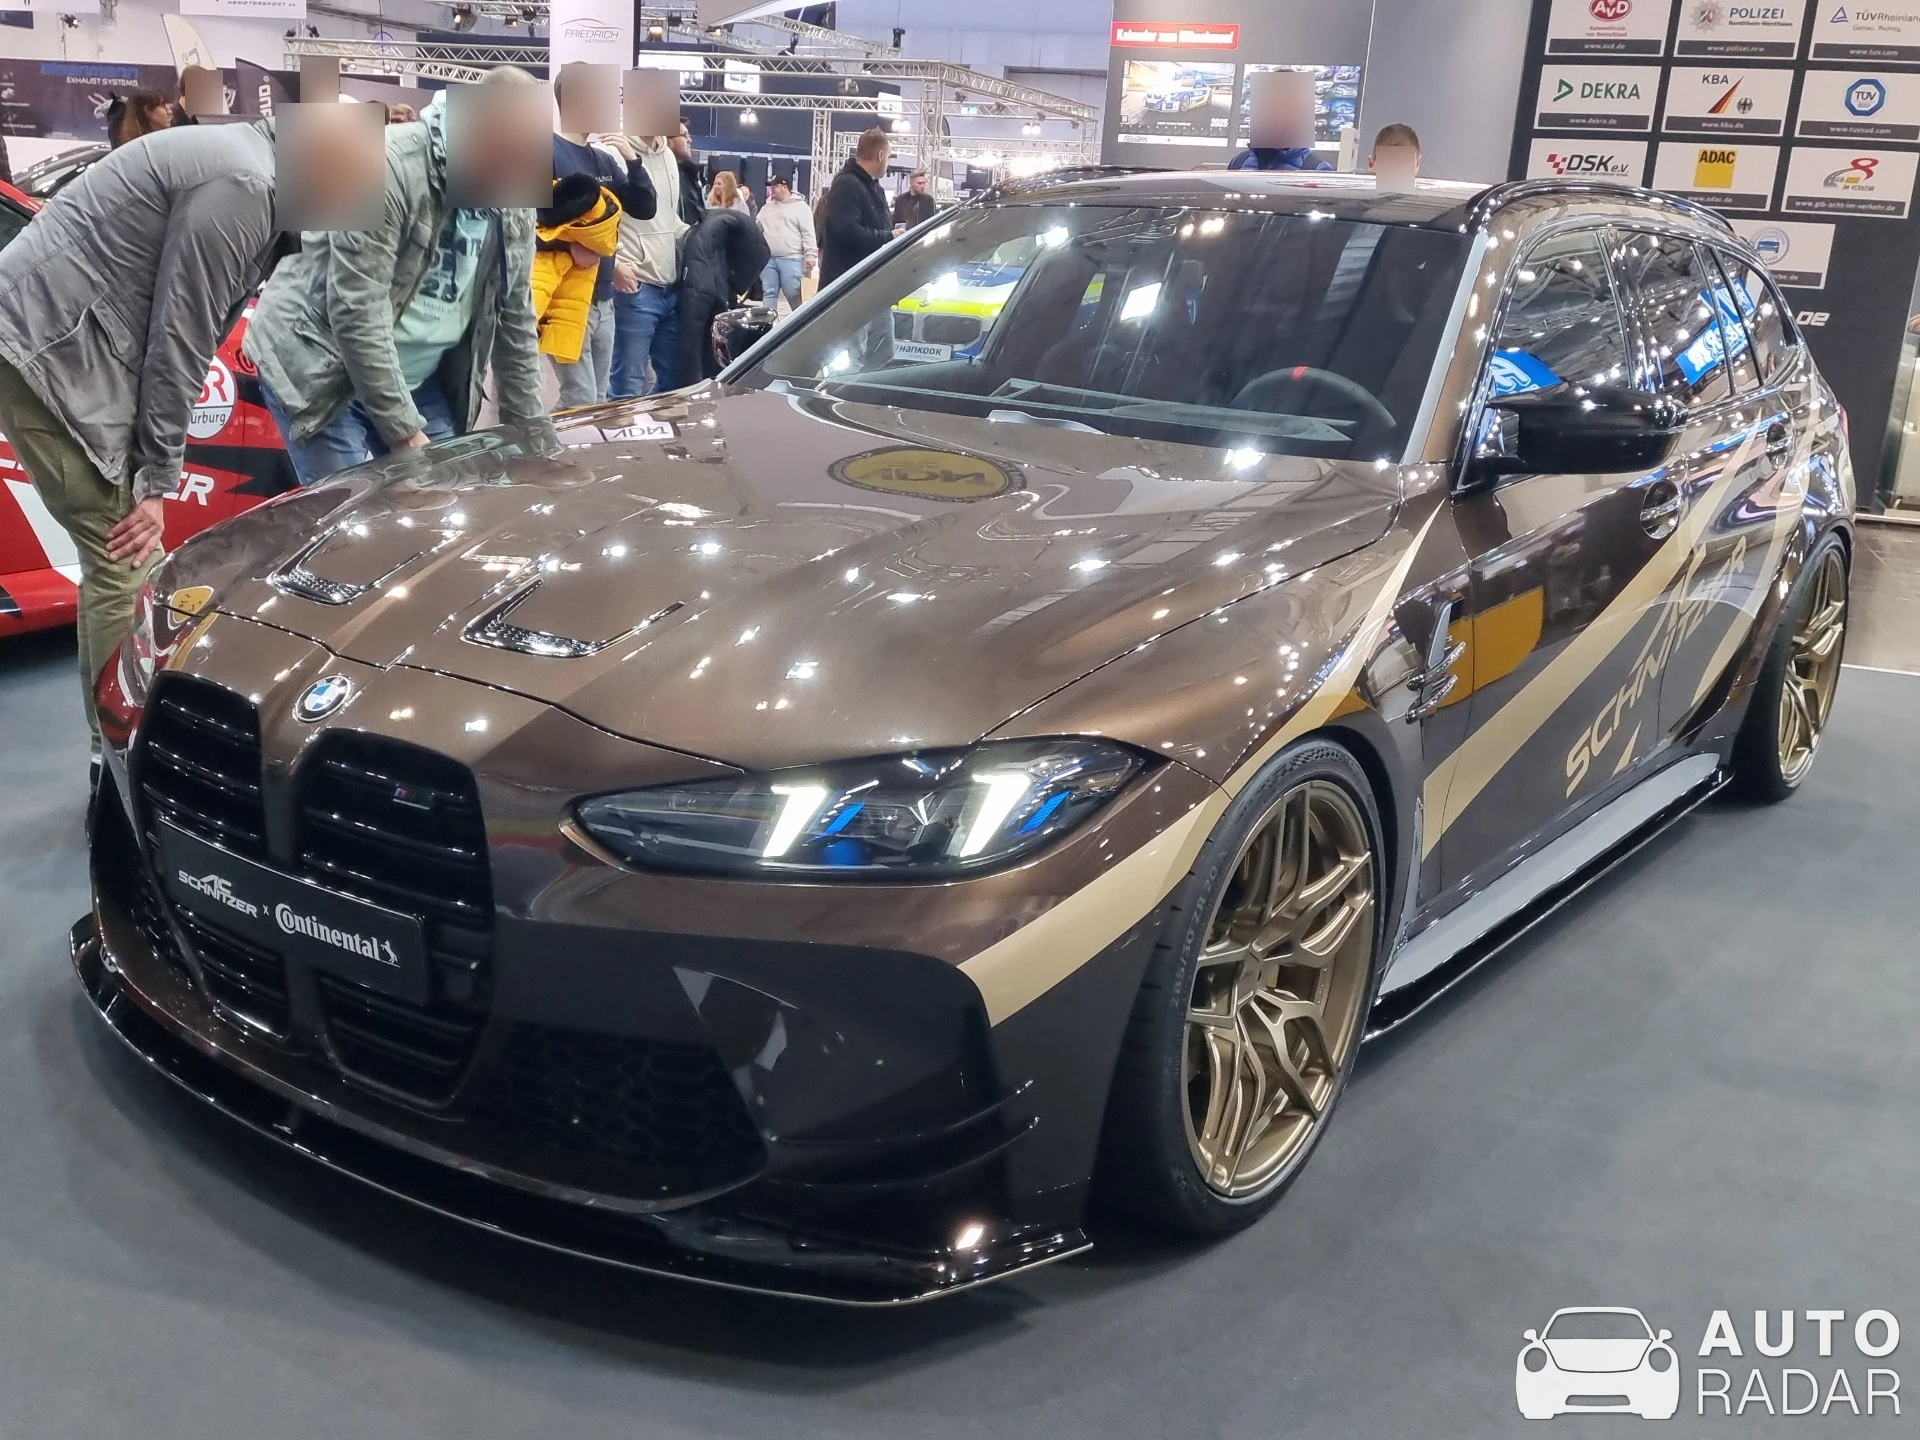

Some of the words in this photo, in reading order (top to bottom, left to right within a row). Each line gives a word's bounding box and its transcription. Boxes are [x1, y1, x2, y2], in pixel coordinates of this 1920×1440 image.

[1729, 7, 1785, 19] POLIZEI
[564, 29, 619, 39] FRIEDRICH
[66, 76, 101, 85] EXHAUST
[102, 77, 139, 87] SYSTEMS
[1701, 74, 1729, 85] KBA
[1580, 82, 1641, 100] DEKRA
[1566, 154, 1614, 172] DSK
[1699, 150, 1736, 164] ADAC
[189, 411, 227, 426] ürburg
[1566, 535, 1747, 800] SCHNITZER
[178, 869, 258, 919] SCHNITZER
[274, 902, 381, 961] Continental
